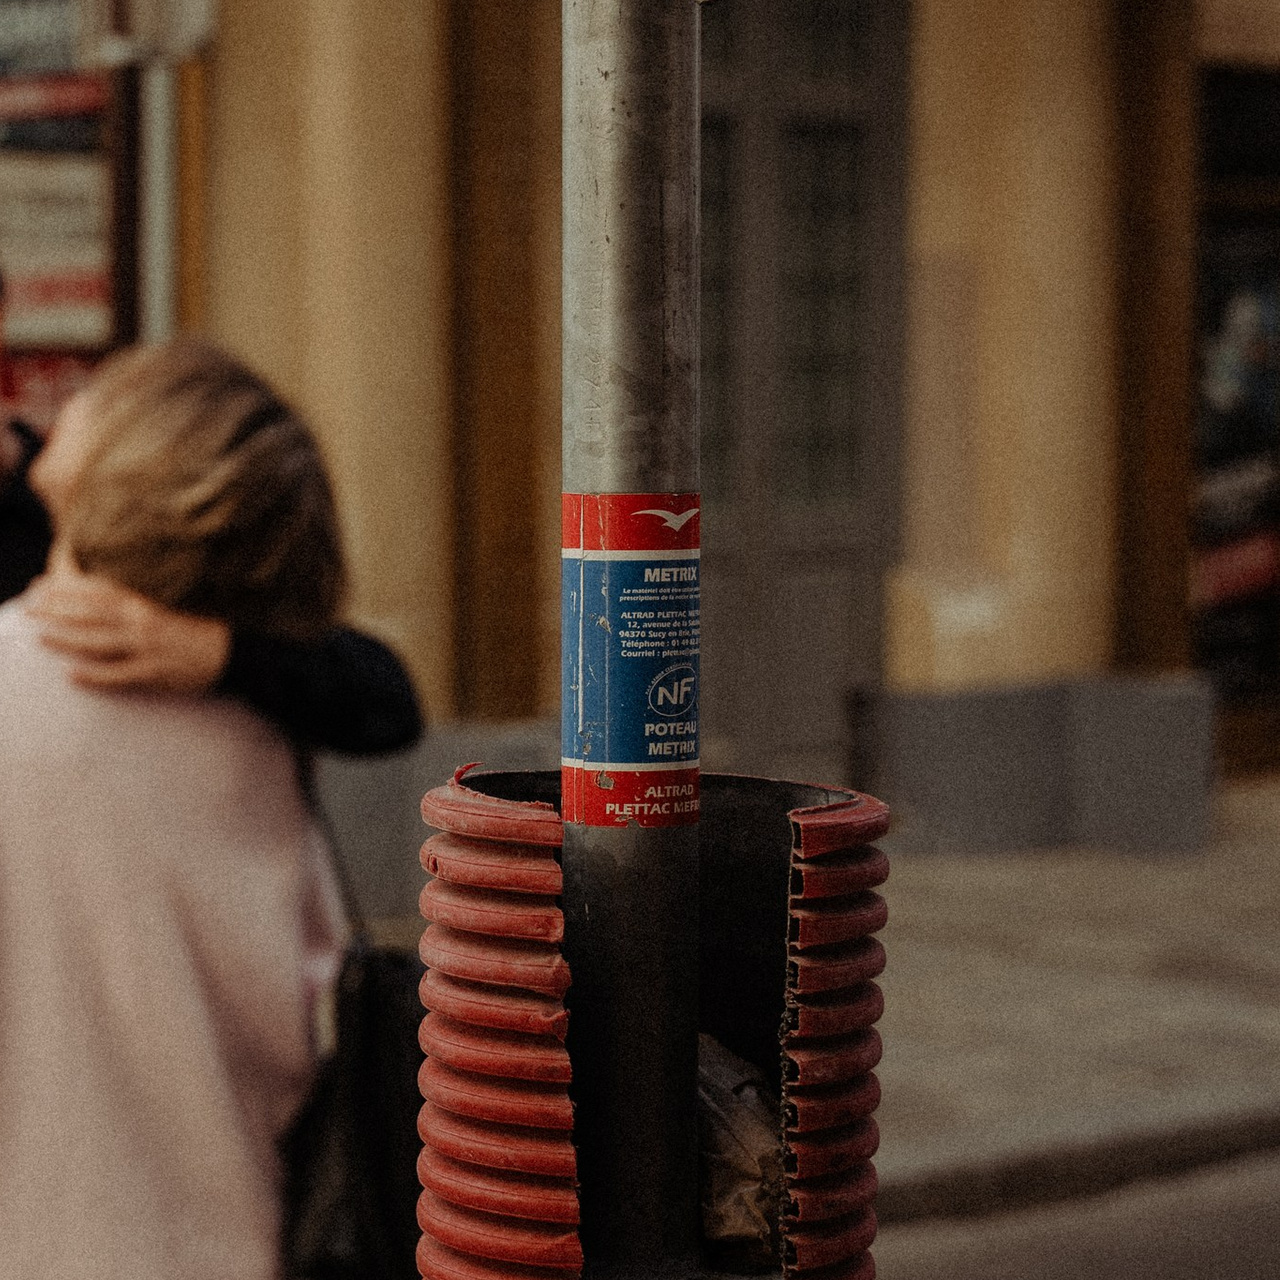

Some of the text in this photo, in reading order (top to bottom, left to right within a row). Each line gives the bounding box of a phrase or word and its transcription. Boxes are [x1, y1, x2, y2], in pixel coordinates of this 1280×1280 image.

[644, 568, 697, 582] METRIX
[621, 611, 654, 619] ALTRAD
[657, 610, 686, 618] PLETTAC
[619, 630, 646, 638] 94370
[648, 630, 666, 638] Sucy
[621, 639, 665, 648] Téléphone
[621, 649, 655, 657] Courriel
[657, 676, 695, 706] NF
[644, 721, 696, 736] POTEAU
[648, 740, 696, 756] METRIX
[646, 784, 694, 798] ALTRAD
[605, 802, 671, 815] PLETTAC
